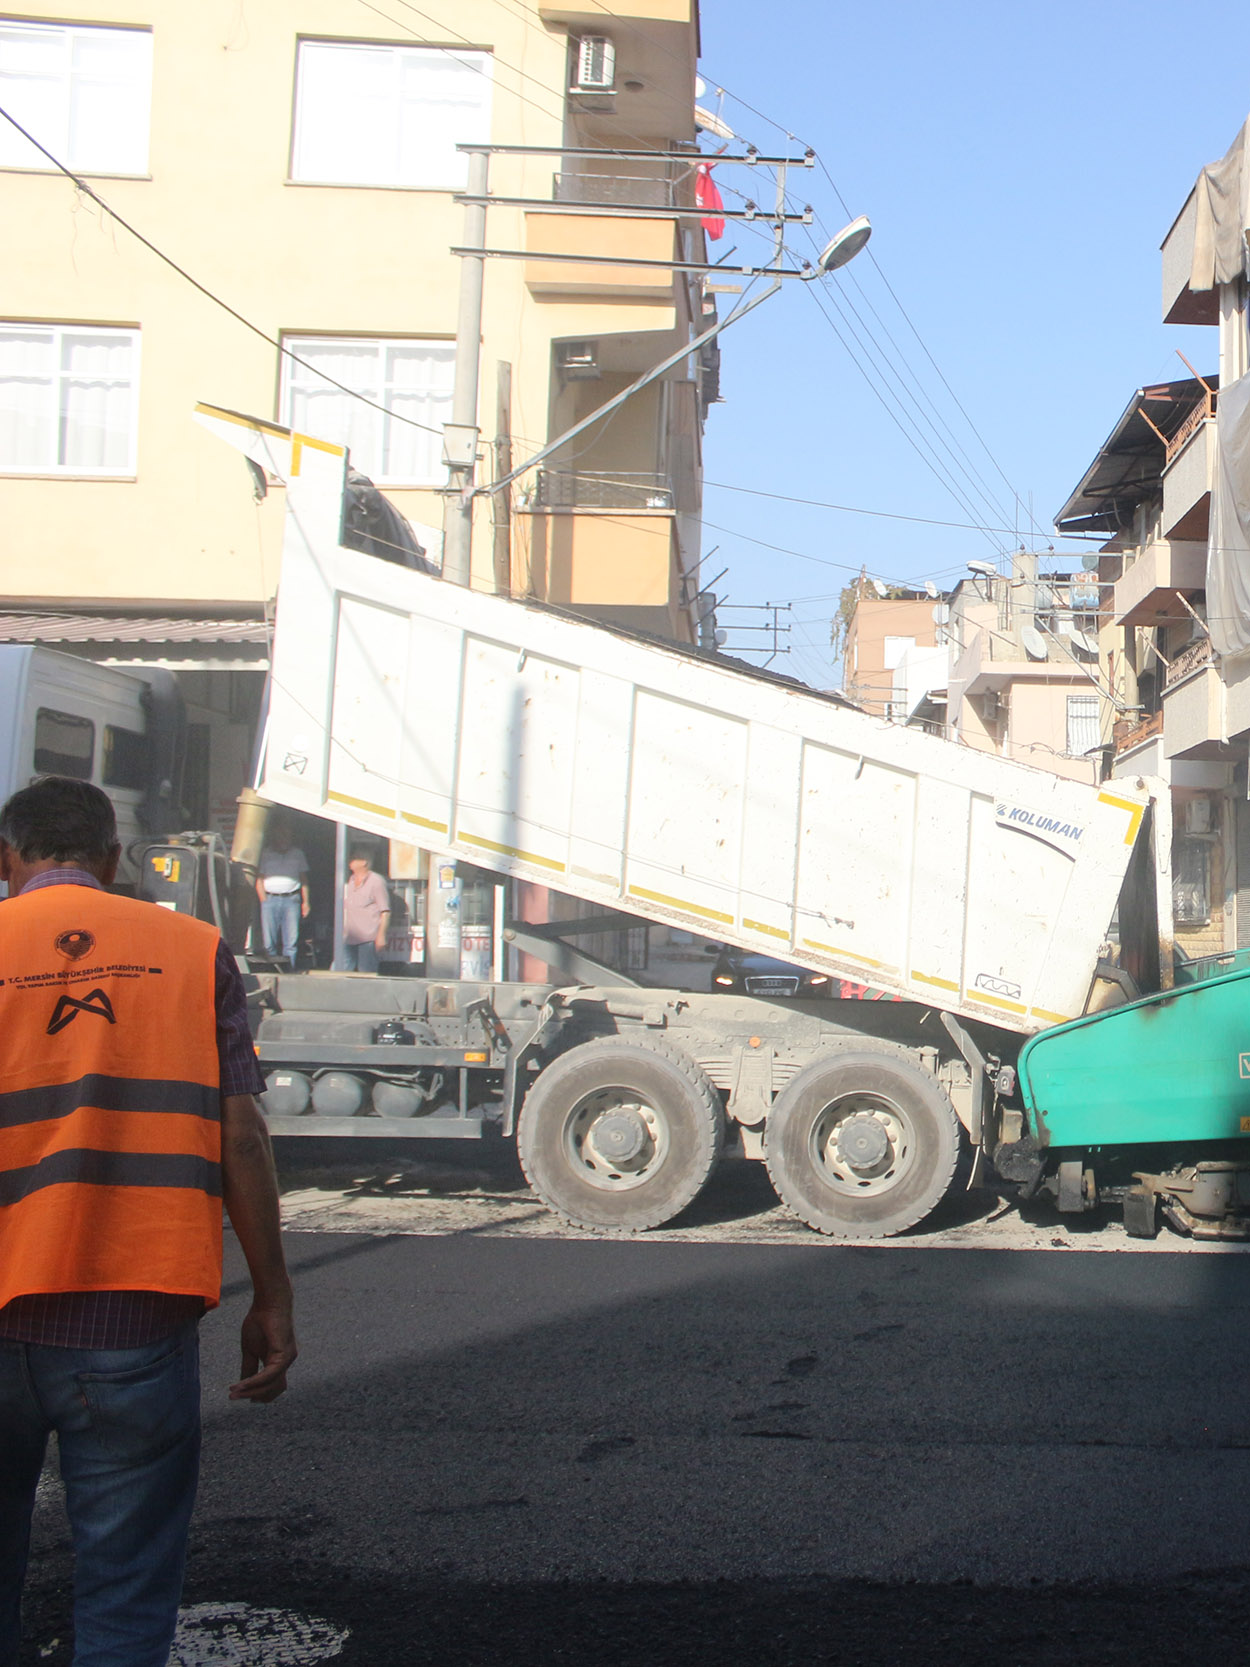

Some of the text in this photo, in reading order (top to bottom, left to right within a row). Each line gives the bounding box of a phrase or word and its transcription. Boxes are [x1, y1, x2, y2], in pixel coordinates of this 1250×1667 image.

[1008, 807, 1084, 840] KOLUMAN
[24, 972, 55, 983] MERSİN
[106, 964, 146, 973] BELEDİYESİ
